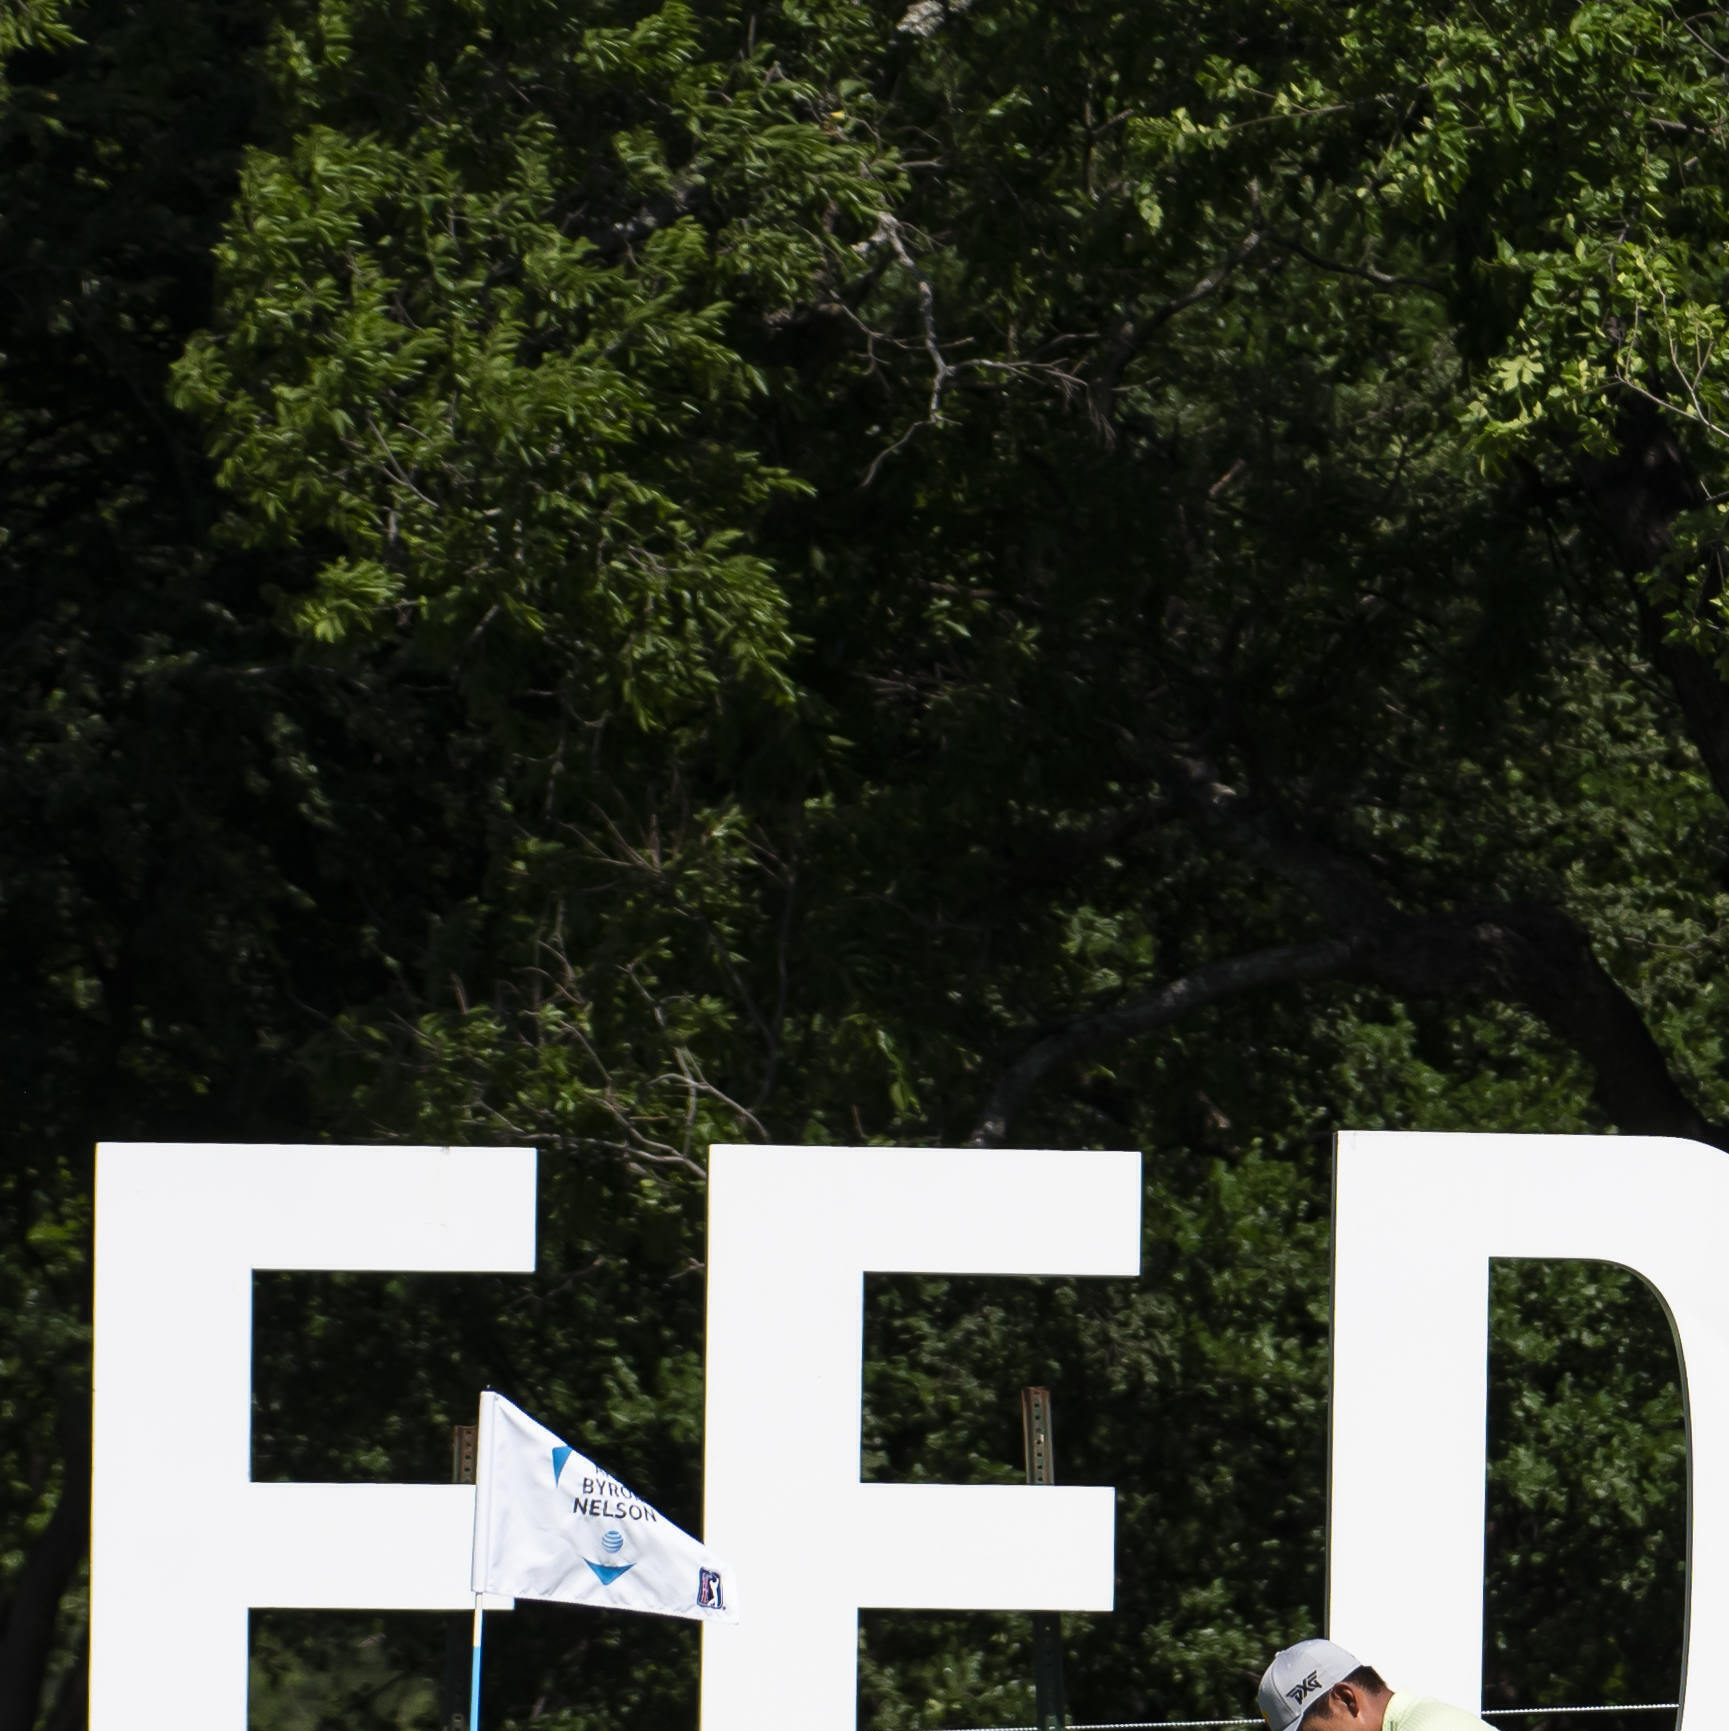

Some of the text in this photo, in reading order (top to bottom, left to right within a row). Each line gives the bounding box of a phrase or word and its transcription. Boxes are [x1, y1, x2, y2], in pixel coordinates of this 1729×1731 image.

[583, 1477, 639, 1500] BYRO
[573, 1497, 657, 1521] NELSON
[1286, 1670, 1322, 1704] PXG
